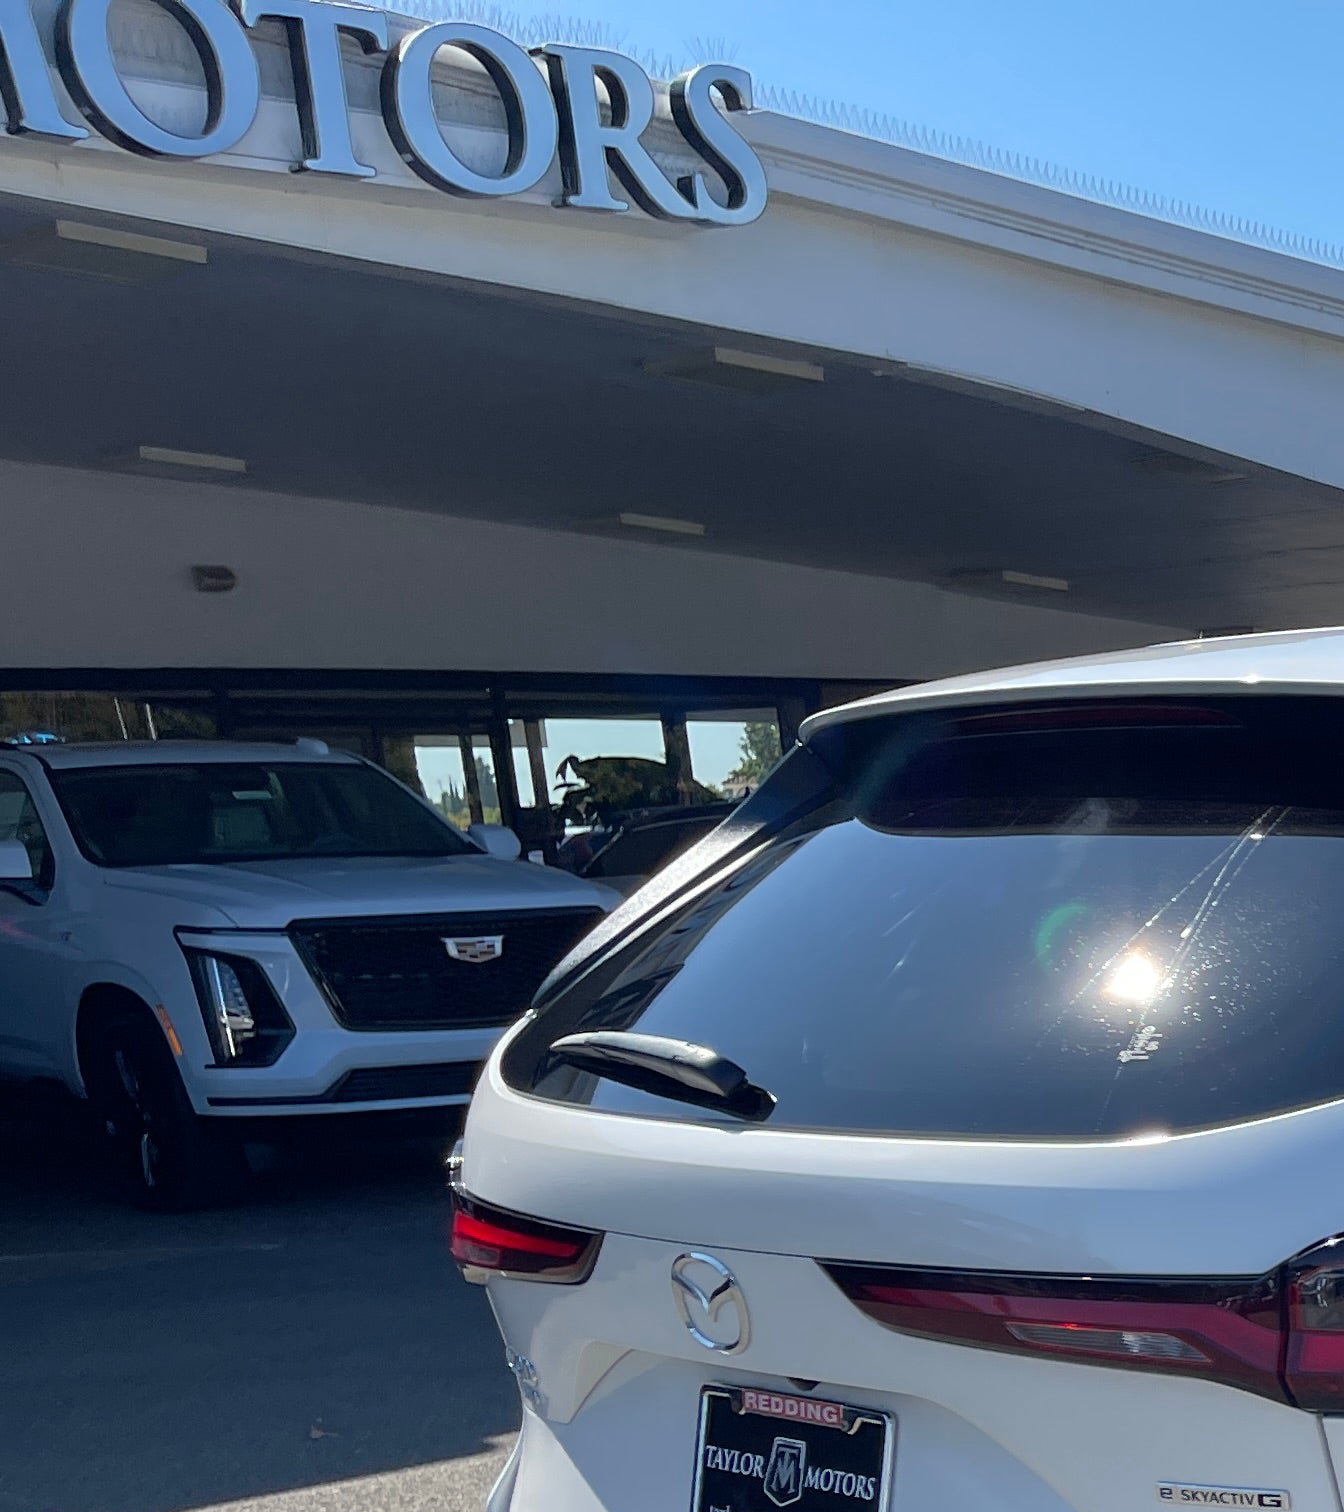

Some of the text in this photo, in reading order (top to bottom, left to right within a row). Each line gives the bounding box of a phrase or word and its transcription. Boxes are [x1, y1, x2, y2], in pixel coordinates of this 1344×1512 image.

[743, 1390, 838, 1424] REDDING
[705, 1445, 765, 1479] TAYLOR
[803, 1465, 876, 1500] MOTORS
